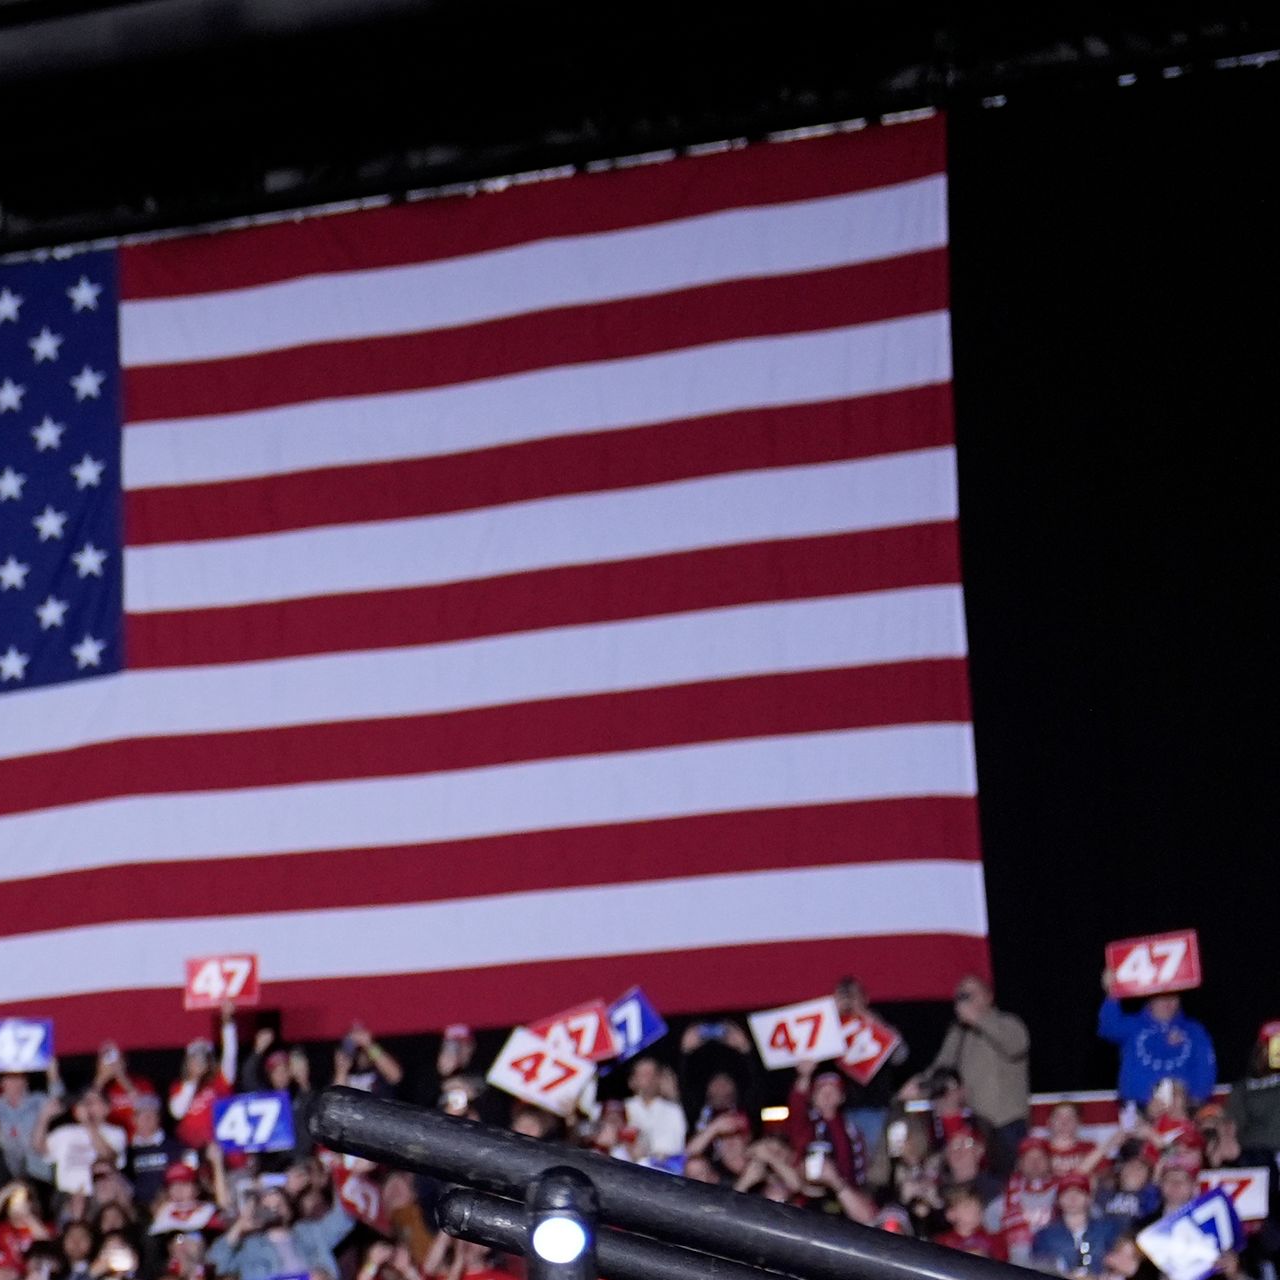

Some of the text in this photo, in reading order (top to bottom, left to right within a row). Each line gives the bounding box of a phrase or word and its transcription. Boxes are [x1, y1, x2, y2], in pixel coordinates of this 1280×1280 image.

[192, 959, 253, 1000] 47
[1116, 938, 1187, 987] 47
[768, 1013, 825, 1054] 47
[509, 1051, 578, 1092] 47
[216, 1098, 281, 1146] 47
